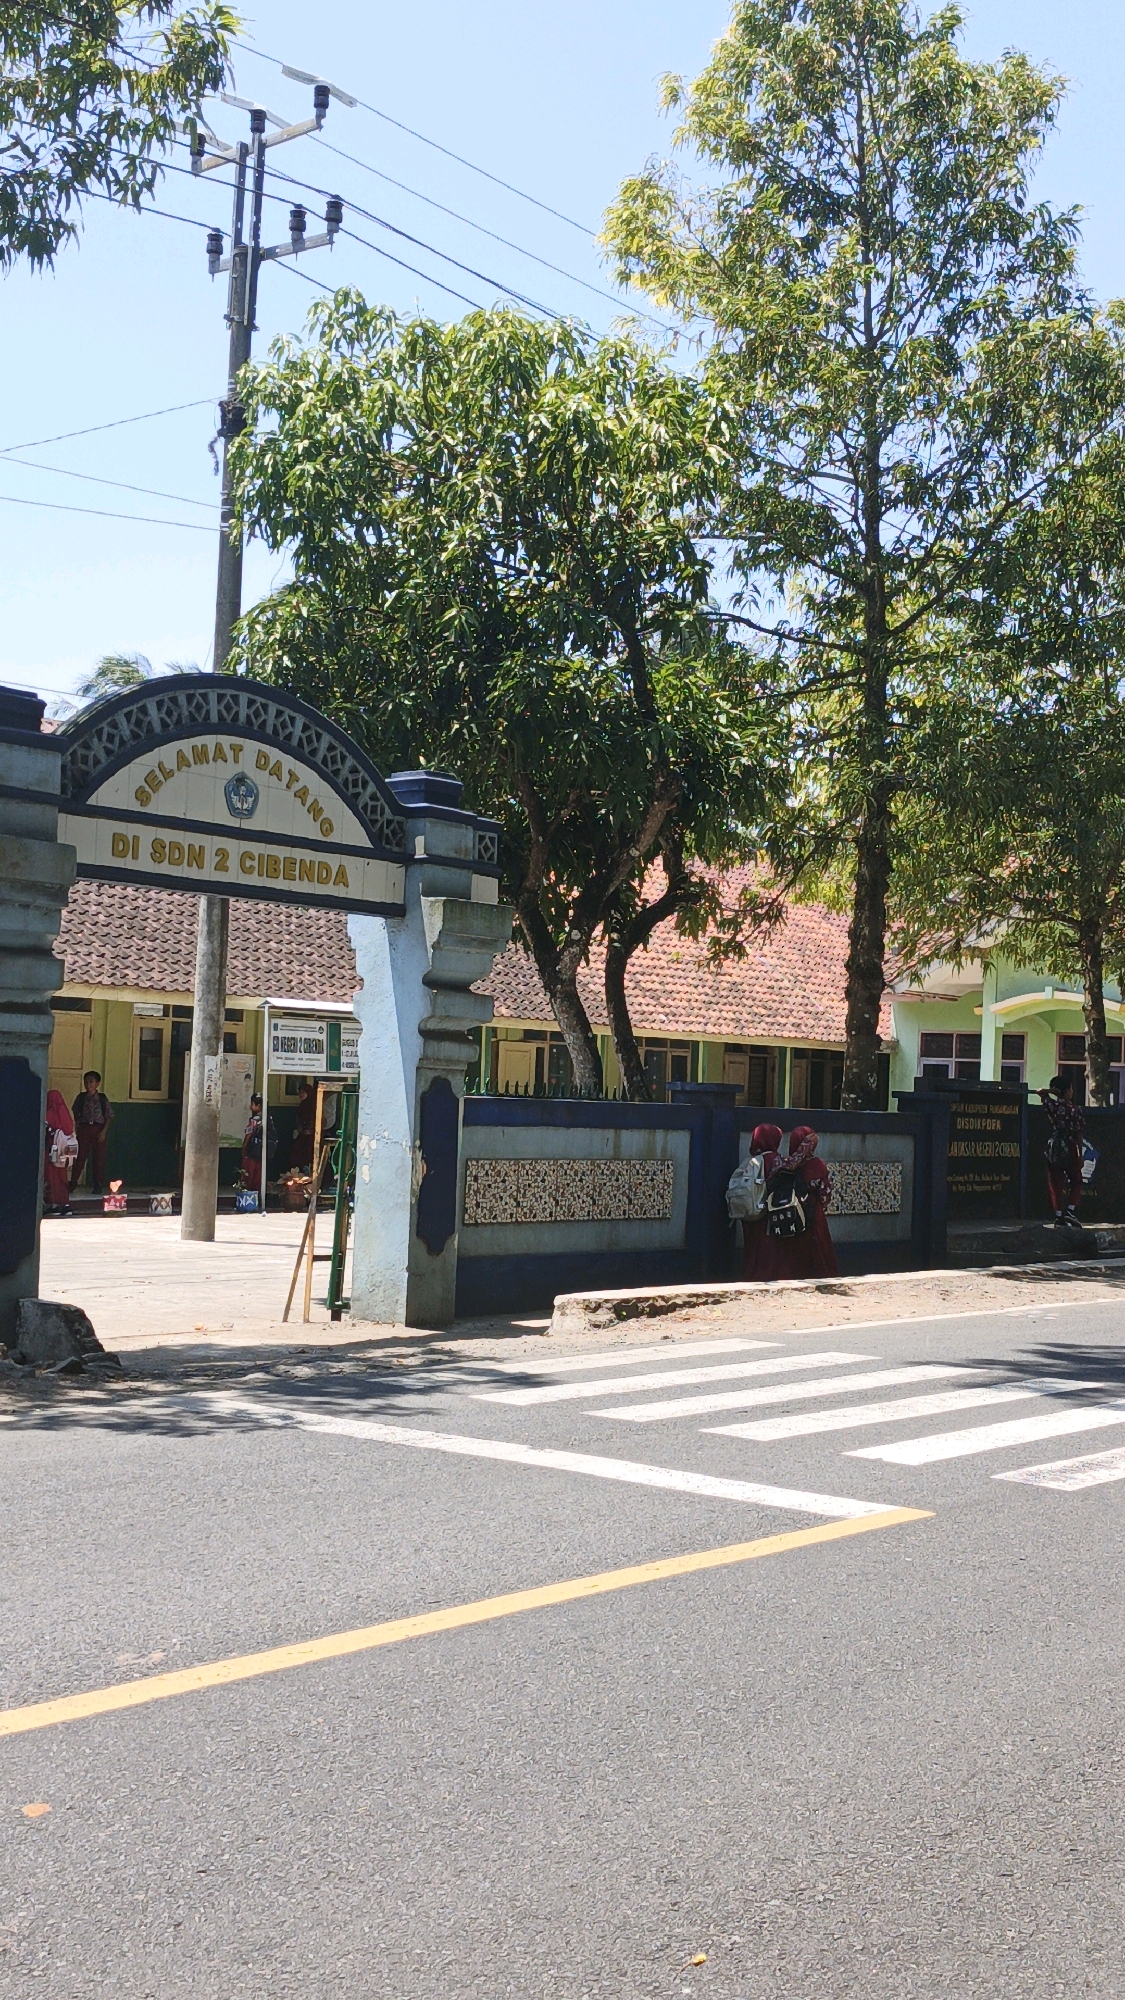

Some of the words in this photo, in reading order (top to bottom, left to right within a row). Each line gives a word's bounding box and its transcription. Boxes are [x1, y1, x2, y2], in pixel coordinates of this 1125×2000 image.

[135, 742, 244, 807] SELAMAT
[256, 749, 335, 837] DATANG
[112, 832, 140, 860] DI
[150, 838, 206, 870] SDN
[214, 847, 230, 872] 2
[239, 850, 350, 888] CIBENDA
